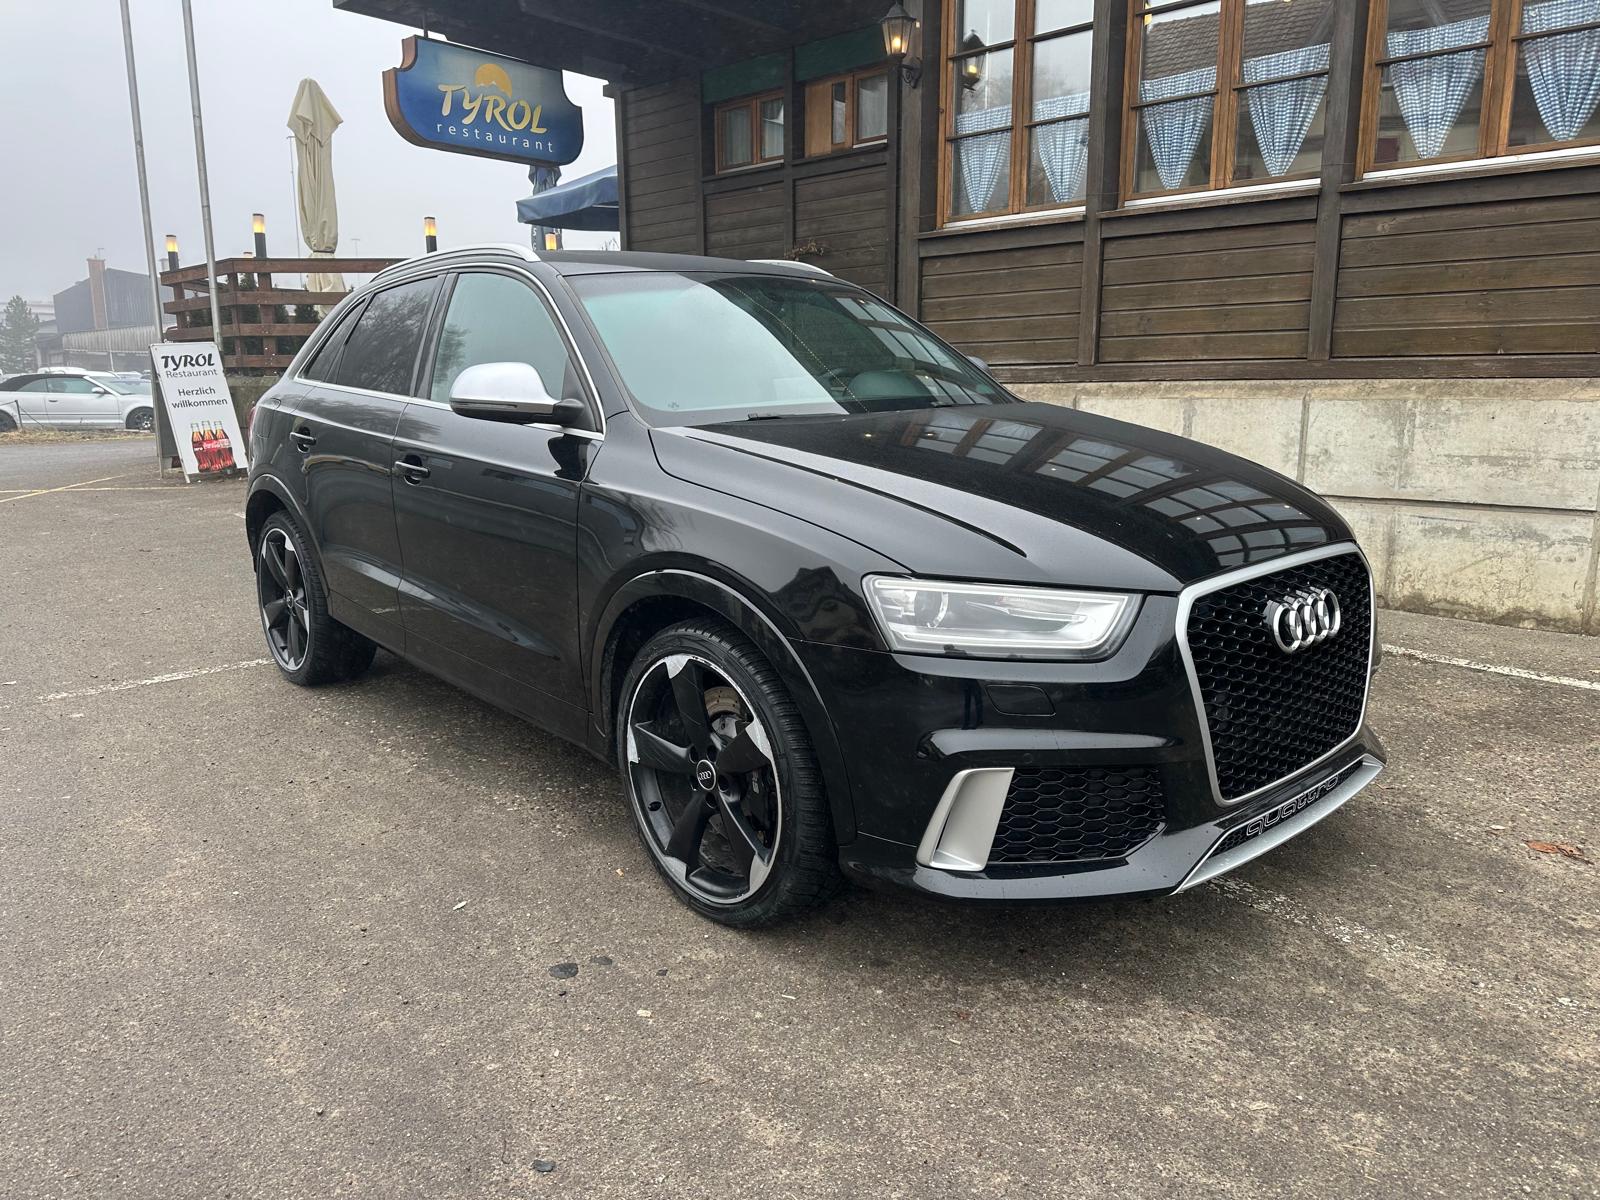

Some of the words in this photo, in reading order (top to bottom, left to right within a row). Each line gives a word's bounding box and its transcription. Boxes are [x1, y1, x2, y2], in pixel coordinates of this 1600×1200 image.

[438, 84, 547, 134] TYROL
[437, 123, 553, 152] restaurant
[161, 353, 215, 371] TYROL
[166, 369, 218, 378] Restaurant
[178, 387, 216, 396] Herzlich
[171, 399, 228, 409] willkommen
[1246, 775, 1339, 836] quattro
